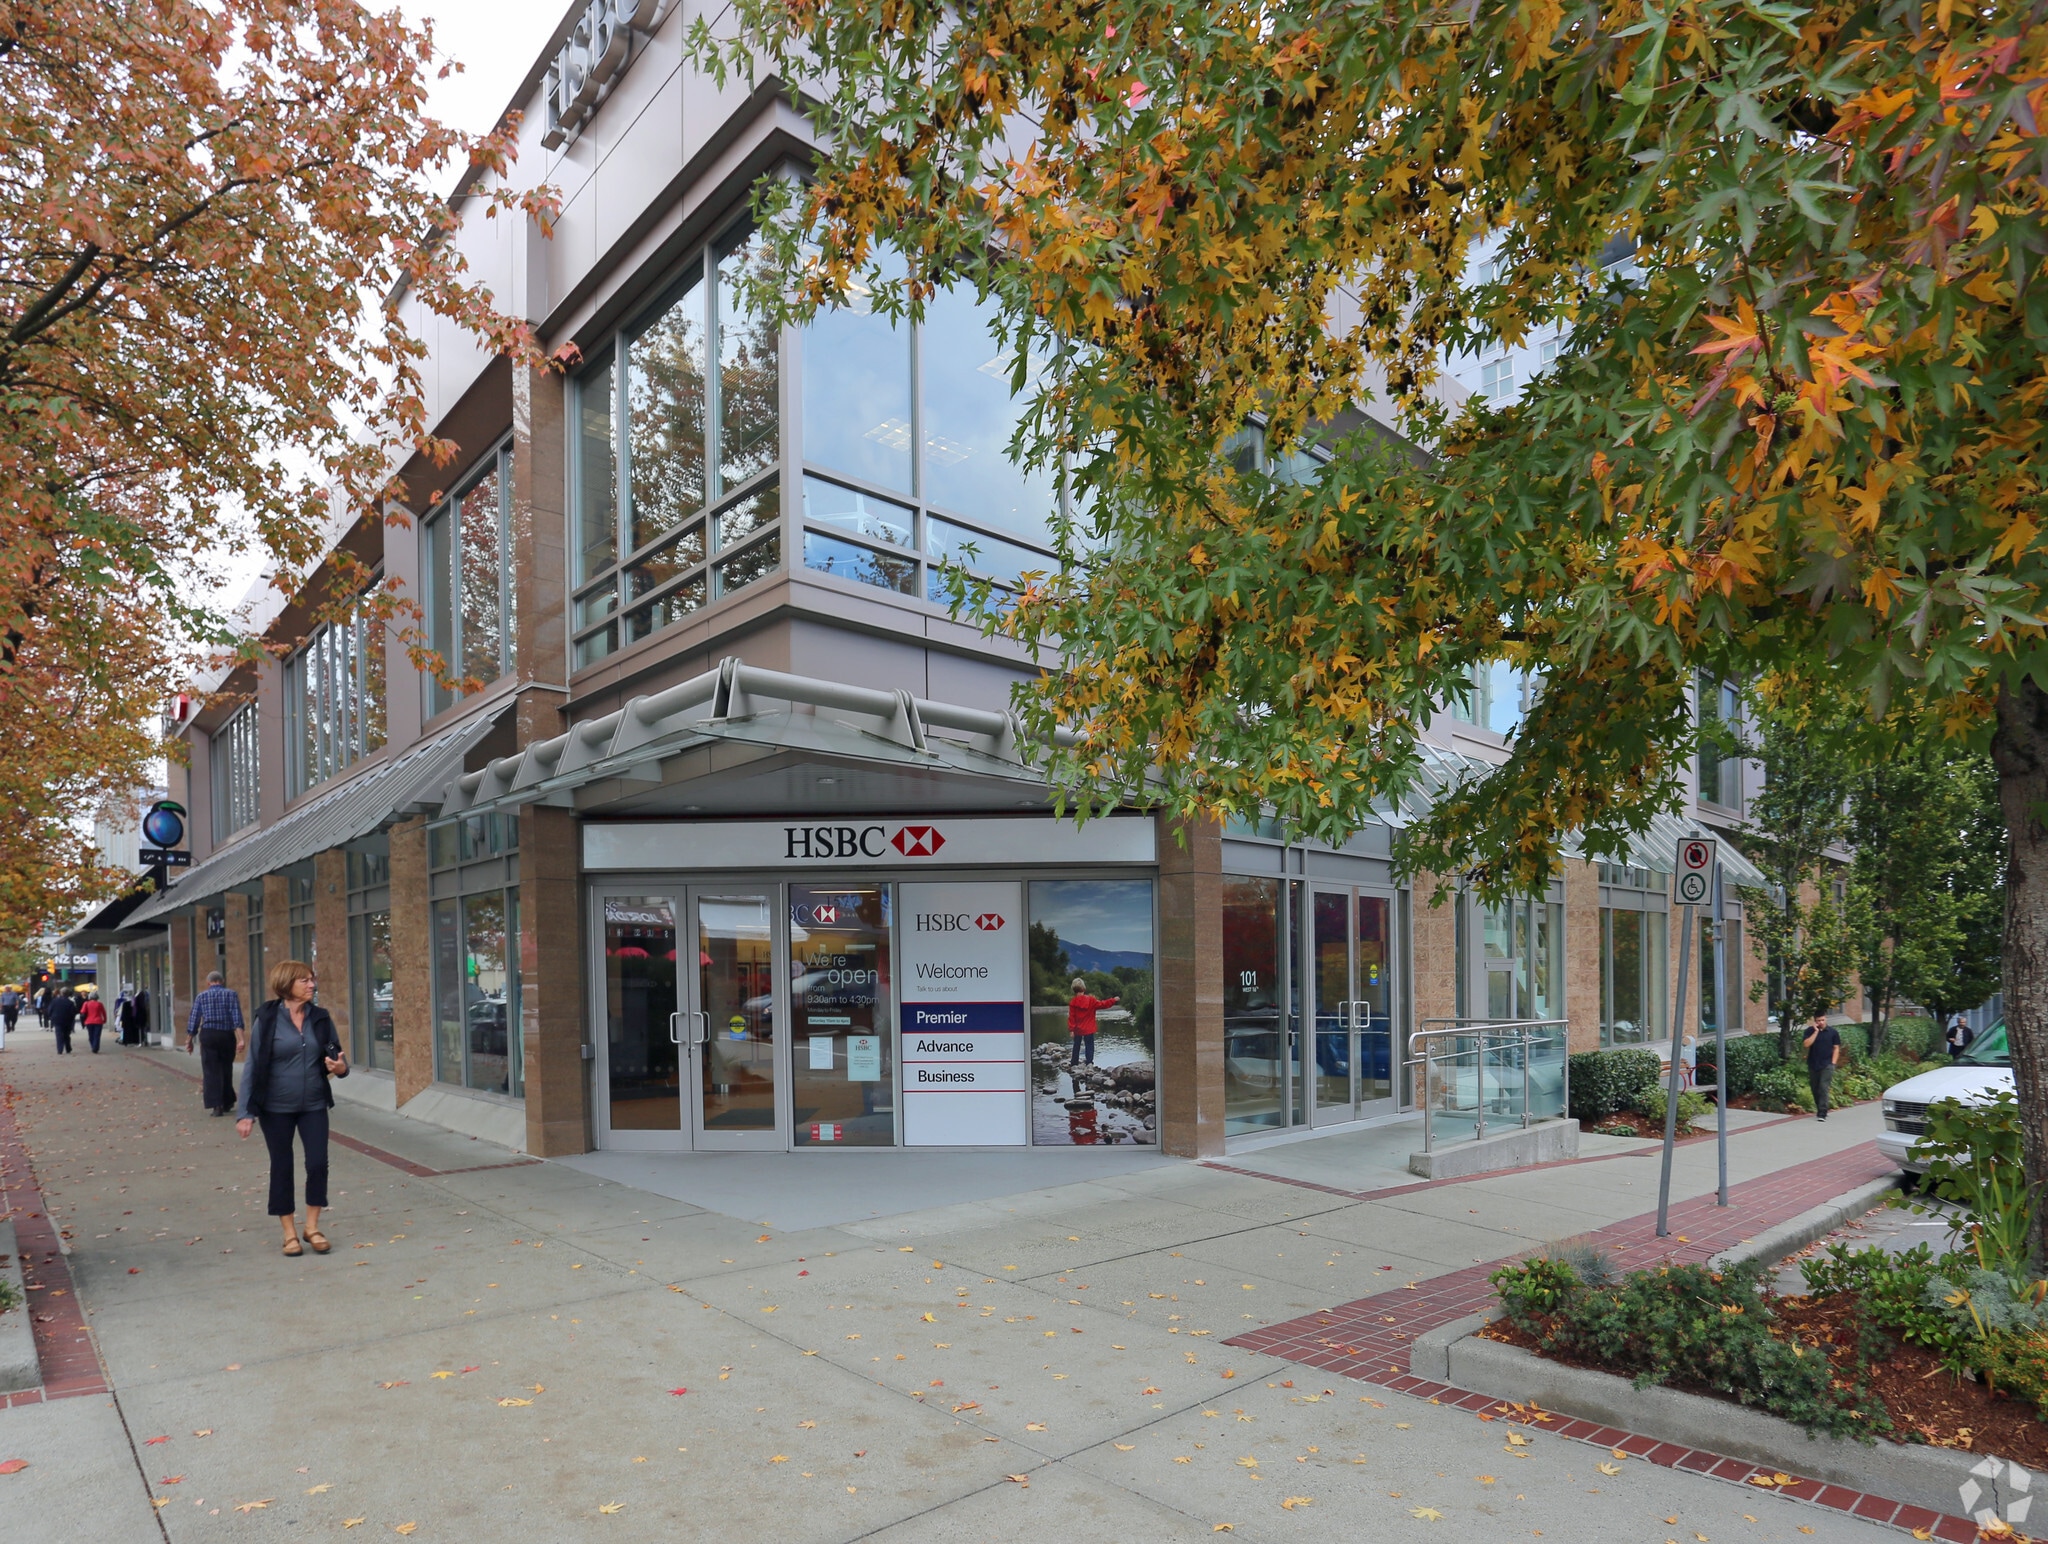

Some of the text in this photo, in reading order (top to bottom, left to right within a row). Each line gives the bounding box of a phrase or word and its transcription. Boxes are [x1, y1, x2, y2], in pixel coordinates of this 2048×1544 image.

[540, 0, 658, 151] HSB
[784, 826, 886, 858] HSBC
[915, 913, 971, 932] HSBC
[805, 952, 847, 967] We're
[916, 963, 989, 979] Welcome
[1240, 970, 1257, 986] 101
[827, 969, 879, 989] open
[917, 985, 926, 993] Talk
[942, 985, 958, 993] about
[839, 995, 848, 1004] to
[916, 1010, 968, 1024] Premier
[916, 1039, 974, 1053] Advance
[918, 1069, 975, 1083] Business
